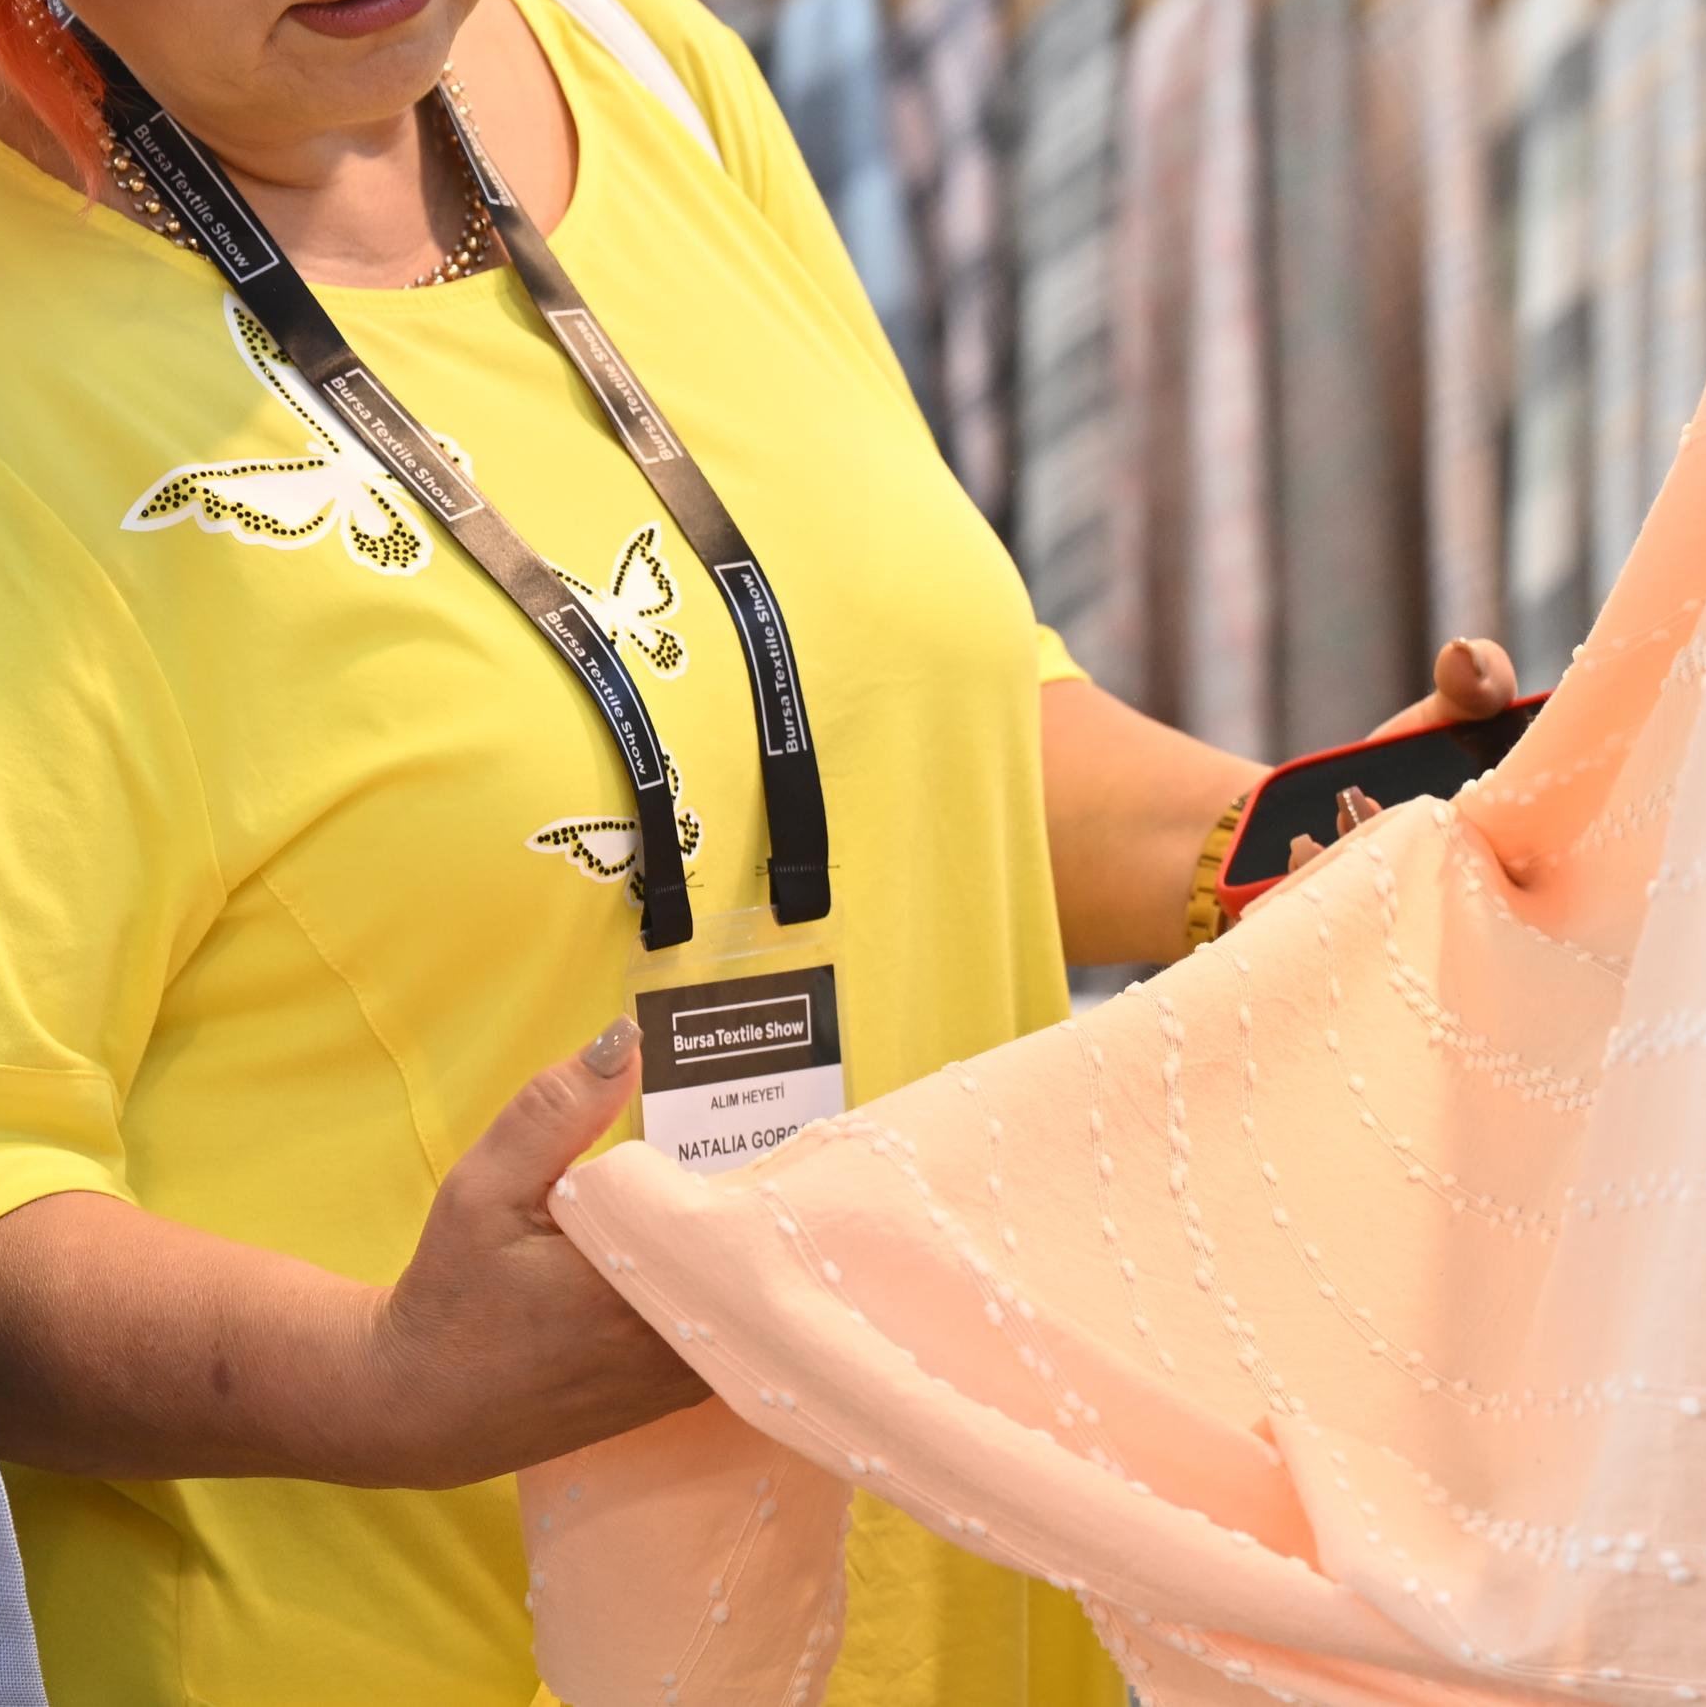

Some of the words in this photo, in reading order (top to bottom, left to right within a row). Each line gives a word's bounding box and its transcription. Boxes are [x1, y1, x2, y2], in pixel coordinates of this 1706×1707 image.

[133, 124, 173, 173] Bursa
[170, 168, 214, 223] Textile
[211, 222, 250, 268] Show
[574, 319, 609, 363] Show
[604, 362, 642, 416] Textile
[330, 376, 372, 421] Bursa
[370, 417, 417, 468] Textile
[414, 467, 457, 509] Show
[639, 415, 675, 461] Bursa
[740, 572, 771, 623] Show
[764, 625, 788, 693] Textile
[545, 610, 587, 658] Bursa
[585, 656, 624, 718] Textile
[620, 720, 647, 775] Show
[780, 695, 799, 754] Bursa
[673, 1033, 715, 1052] Bursa
[715, 1024, 763, 1046] Textile
[765, 1020, 804, 1040] Show
[711, 1092, 739, 1110] ALIM
[742, 1081, 785, 1105] HEYETİ
[678, 1133, 748, 1162] NATALIA
